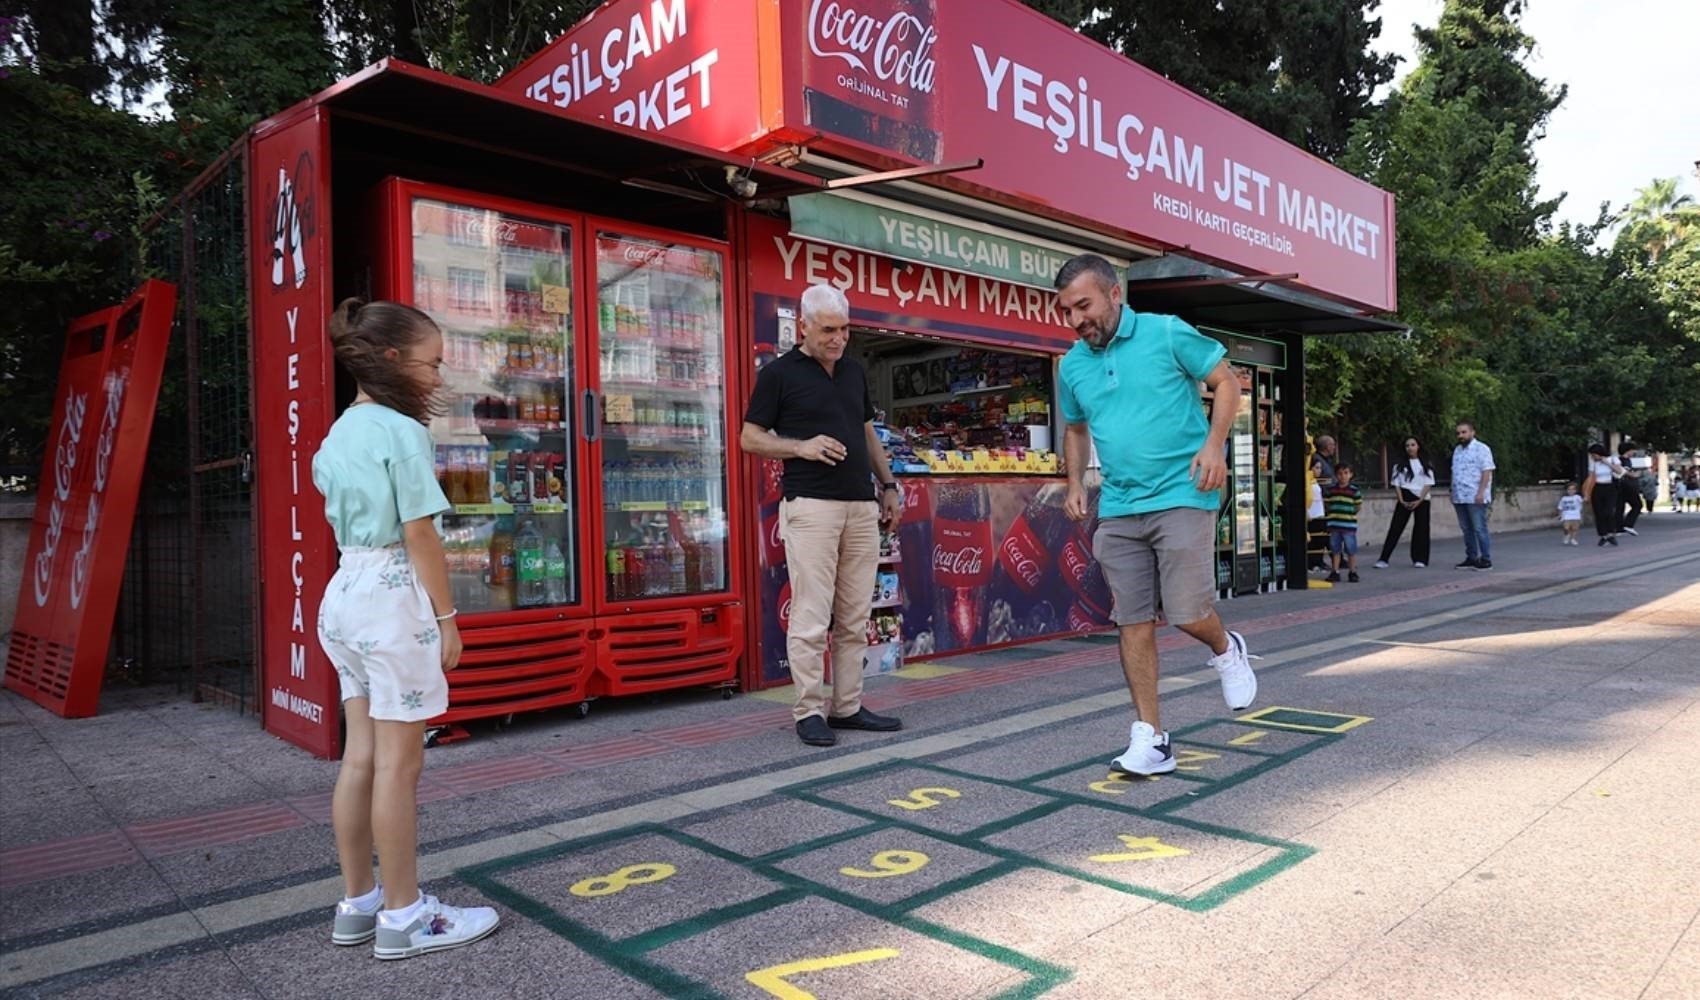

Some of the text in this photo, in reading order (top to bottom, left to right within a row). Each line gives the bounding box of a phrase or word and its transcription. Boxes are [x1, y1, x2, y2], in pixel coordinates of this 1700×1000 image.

[808, 0, 938, 93] Coca-Cola
[890, 93, 909, 109] TAT
[971, 43, 1380, 260] YEŞİLÇAM JET MARKET
[1153, 192, 1193, 222] KREDİ
[1195, 207, 1230, 236] KARTI
[878, 215, 1068, 281] YEŞİLÇAM BÜF
[978, 278, 1073, 328] MARK
[34, 384, 88, 607] Coca-Cola
[286, 306, 305, 680] YEŞİLÇAM
[932, 543, 983, 574] Coca-Cola
[290, 694, 323, 725] MARKET
[568, 862, 679, 897] 8
